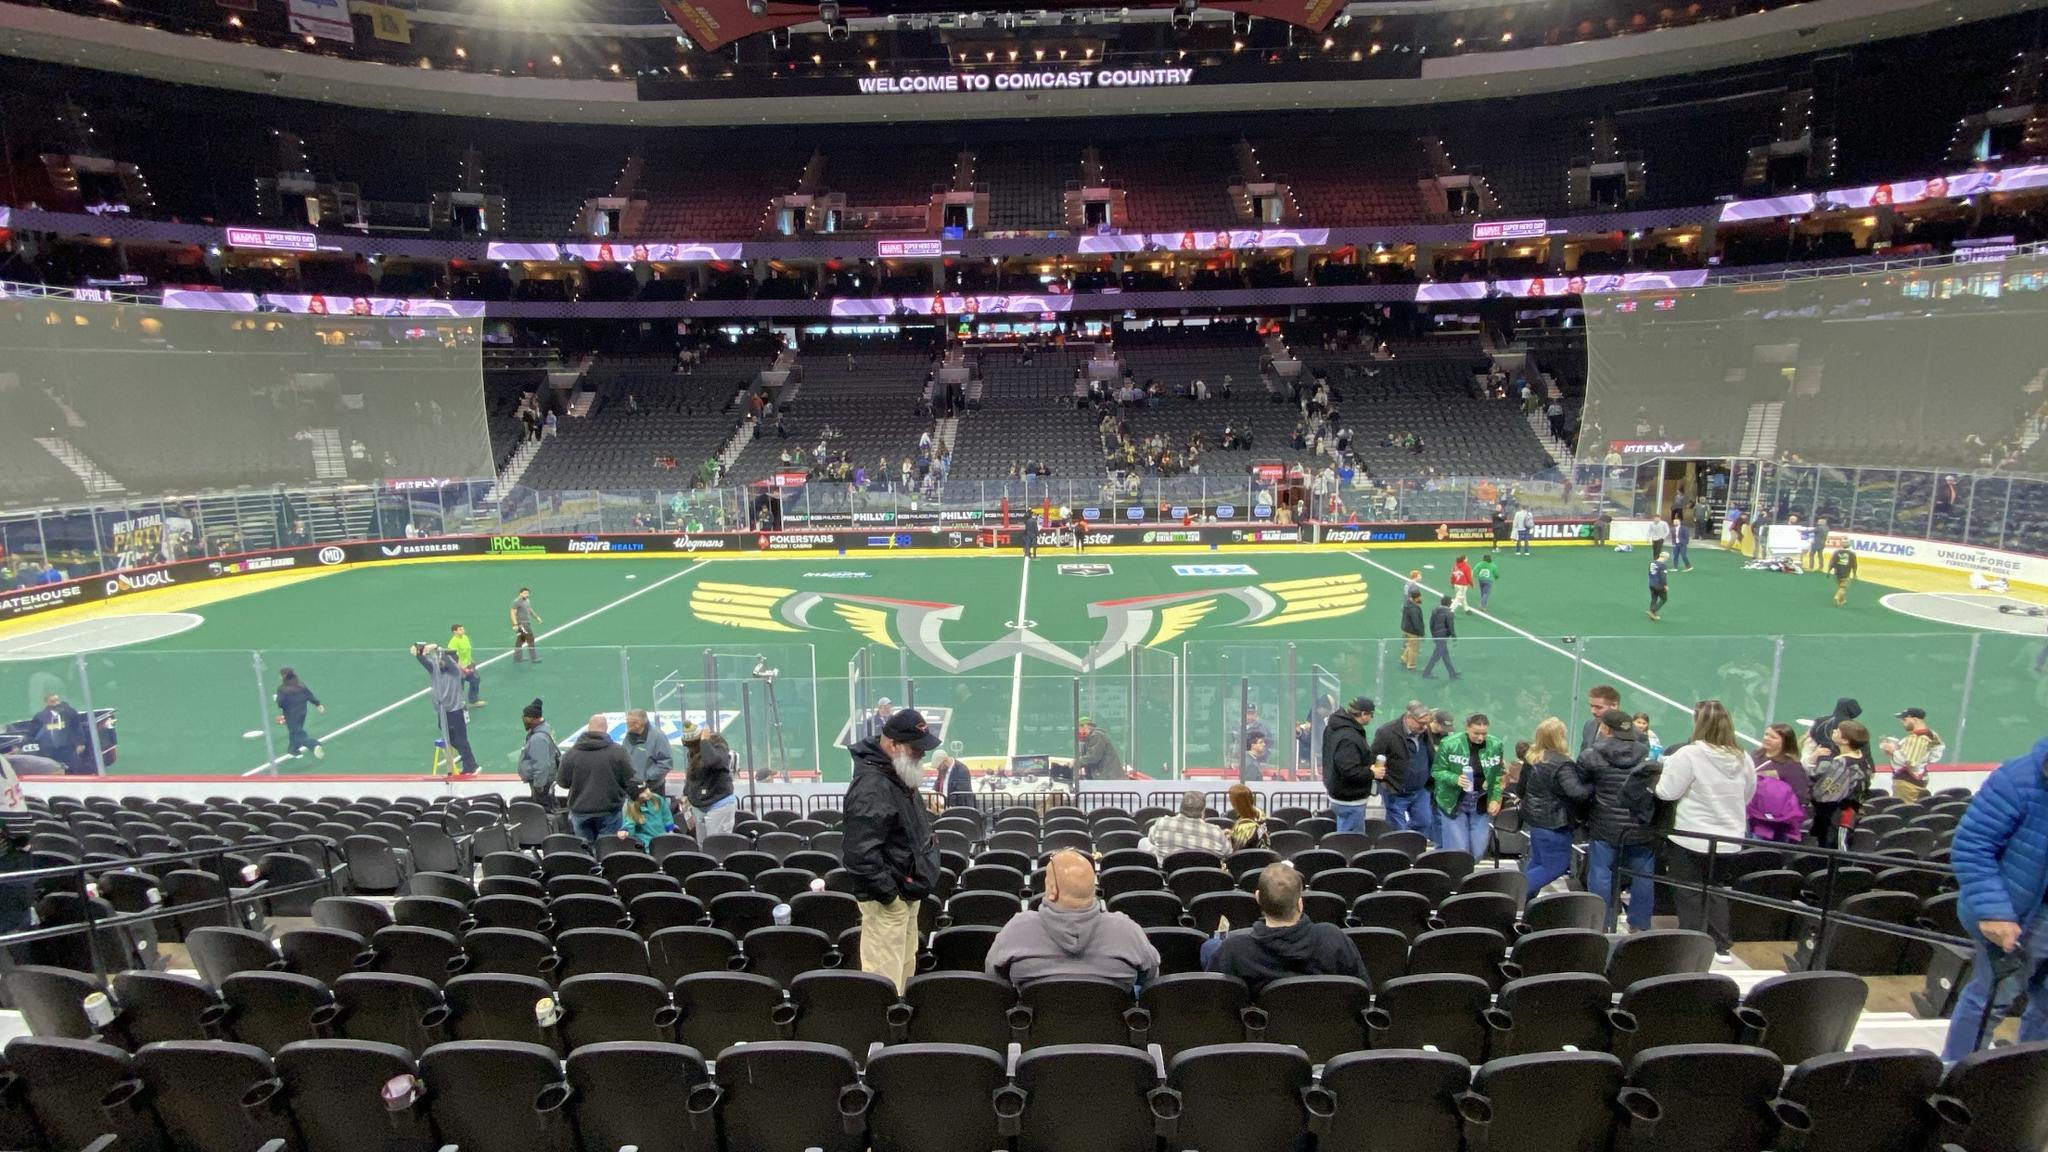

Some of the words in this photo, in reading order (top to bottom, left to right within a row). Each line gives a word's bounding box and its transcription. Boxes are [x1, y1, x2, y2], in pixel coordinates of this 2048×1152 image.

[858, 76, 958, 92] WELCOME
[962, 74, 989, 90] TO
[995, 71, 1092, 89] COMCAST
[1097, 68, 1193, 86] COUNTRY
[1476, 225, 1502, 237] MARVEL
[1503, 223, 1519, 231] SUPER
[230, 231, 264, 244] MARVEL
[264, 233, 284, 241] SUPER
[285, 234, 301, 242] HERO
[302, 235, 315, 243] DAY
[881, 243, 903, 254] MARVEL
[76, 288, 103, 300] APRIL
[853, 512, 896, 521] PHILLY57
[940, 511, 982, 520] PHILLY57
[113, 519, 135, 535] NEW
[137, 514, 163, 529] TRAIL
[114, 525, 162, 553] PARTY
[493, 536, 520, 550] RCR
[769, 534, 834, 544] POKERSTARS
[1036, 530, 1114, 546] ticketaster
[1326, 528, 1371, 544] inspira
[1371, 532, 1406, 540] HEALTH
[403, 543, 459, 554] CASTORE.COM
[568, 539, 610, 554] inspira
[611, 543, 644, 551] HEALTH
[673, 535, 724, 552] Wegmans
[1848, 539, 1915, 558] AMAZING
[324, 549, 340, 562] MD
[1937, 549, 2022, 570] UNION-FORGE
